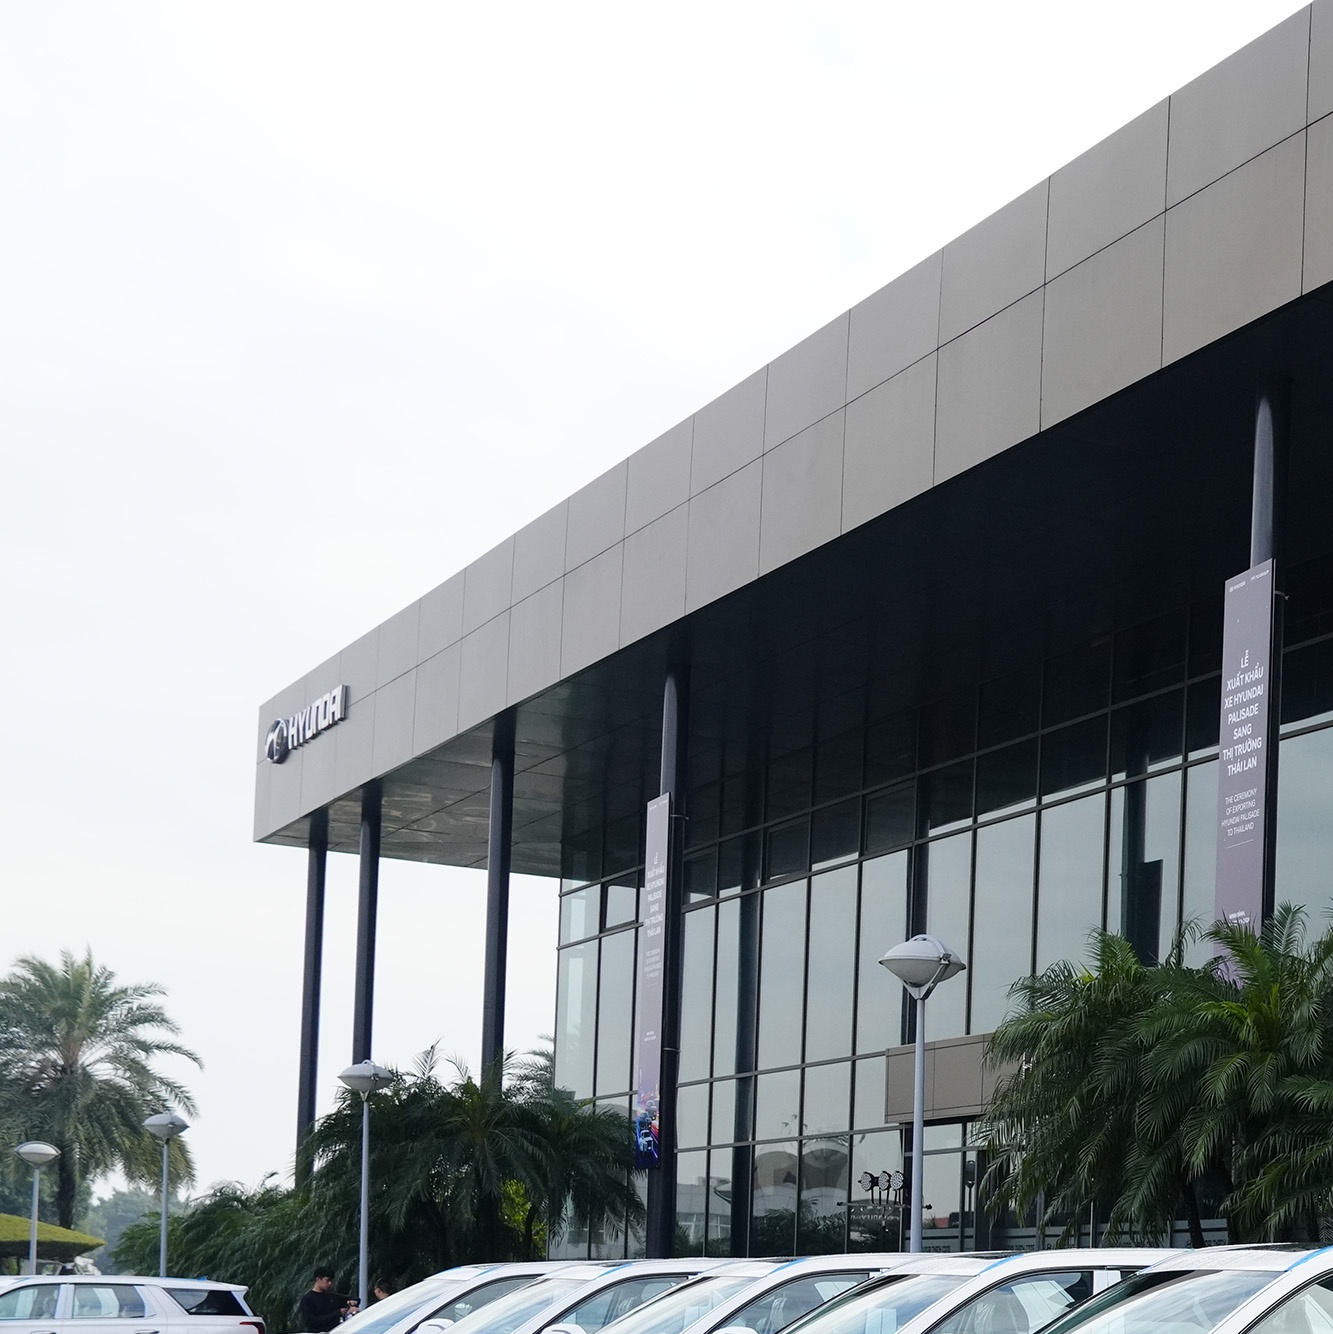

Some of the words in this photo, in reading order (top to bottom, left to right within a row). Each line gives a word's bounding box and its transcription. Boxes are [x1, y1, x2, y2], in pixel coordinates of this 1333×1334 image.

[1224, 696, 1233, 710] XE
[1234, 684, 1264, 706] HYUNDAI
[288, 684, 348, 750] HYUNDAI
[1228, 703, 1259, 725] PALISADE
[1233, 723, 1252, 740] SANG
[1227, 759, 1243, 776] THÁI
